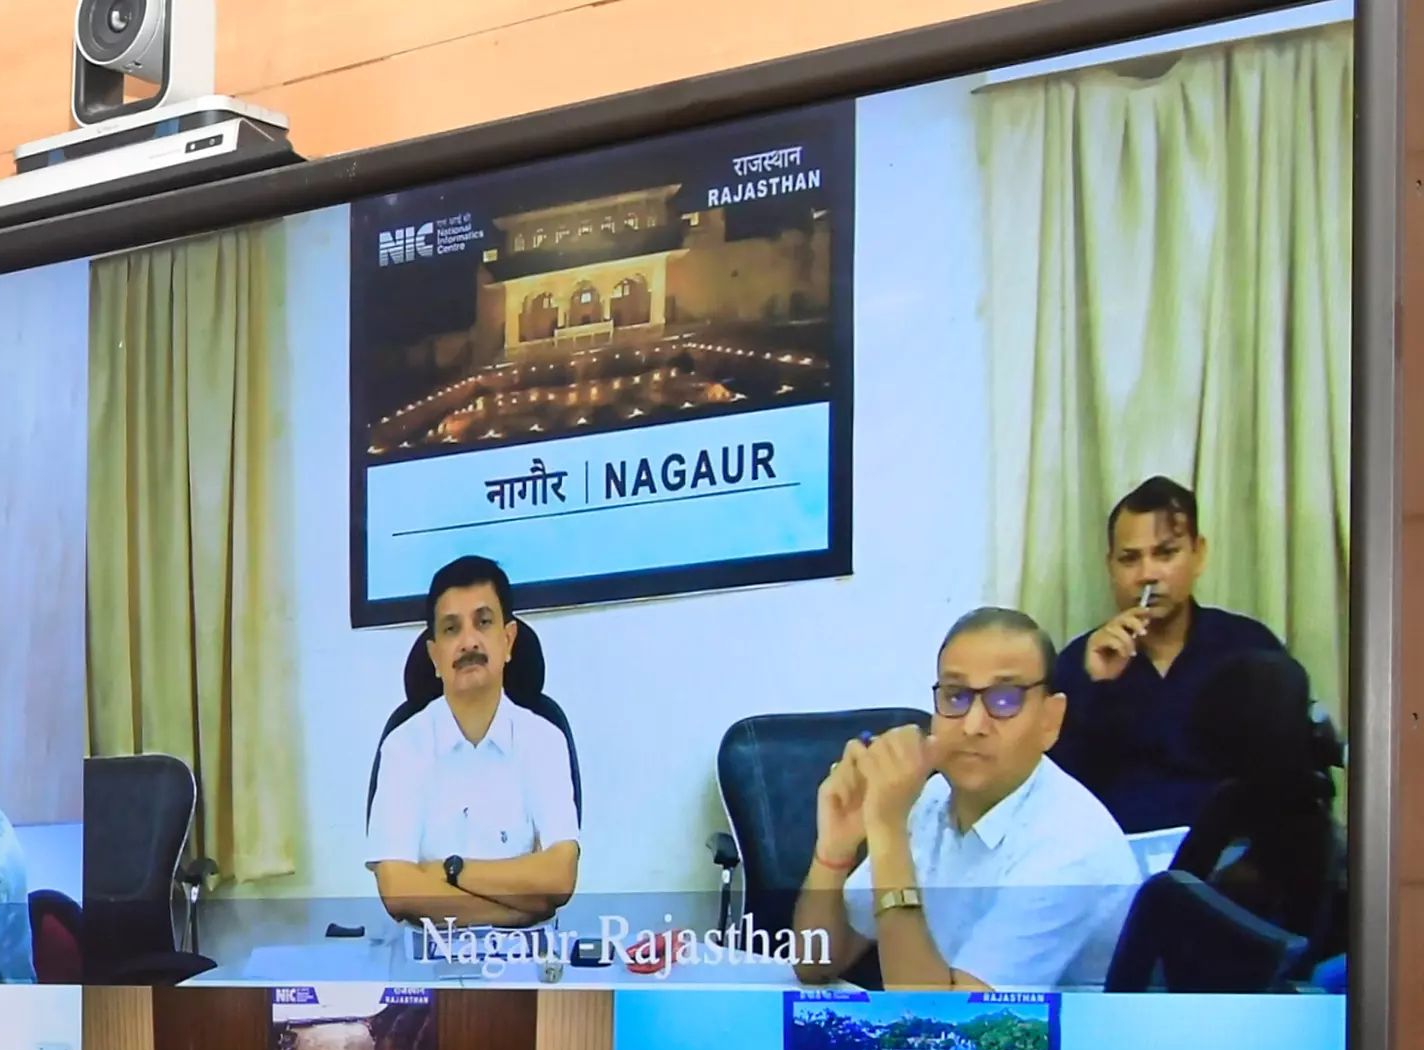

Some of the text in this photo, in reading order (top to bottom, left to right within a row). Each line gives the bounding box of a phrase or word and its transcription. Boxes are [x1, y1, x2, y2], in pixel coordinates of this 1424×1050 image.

[732, 146, 803, 176] राजस्थान
[708, 169, 820, 207] RAJASTHAN
[379, 222, 433, 267] NIC
[437, 223, 471, 237] National
[437, 230, 484, 245] Informatics
[437, 242, 465, 254] Centre
[484, 458, 568, 510] नागौर
[605, 441, 777, 499] NAGAUR
[419, 914, 832, 979] Nagaur-Rajasthan
[276, 988, 296, 1002] NIC
[983, 993, 1045, 1003] RAJASTHAN
